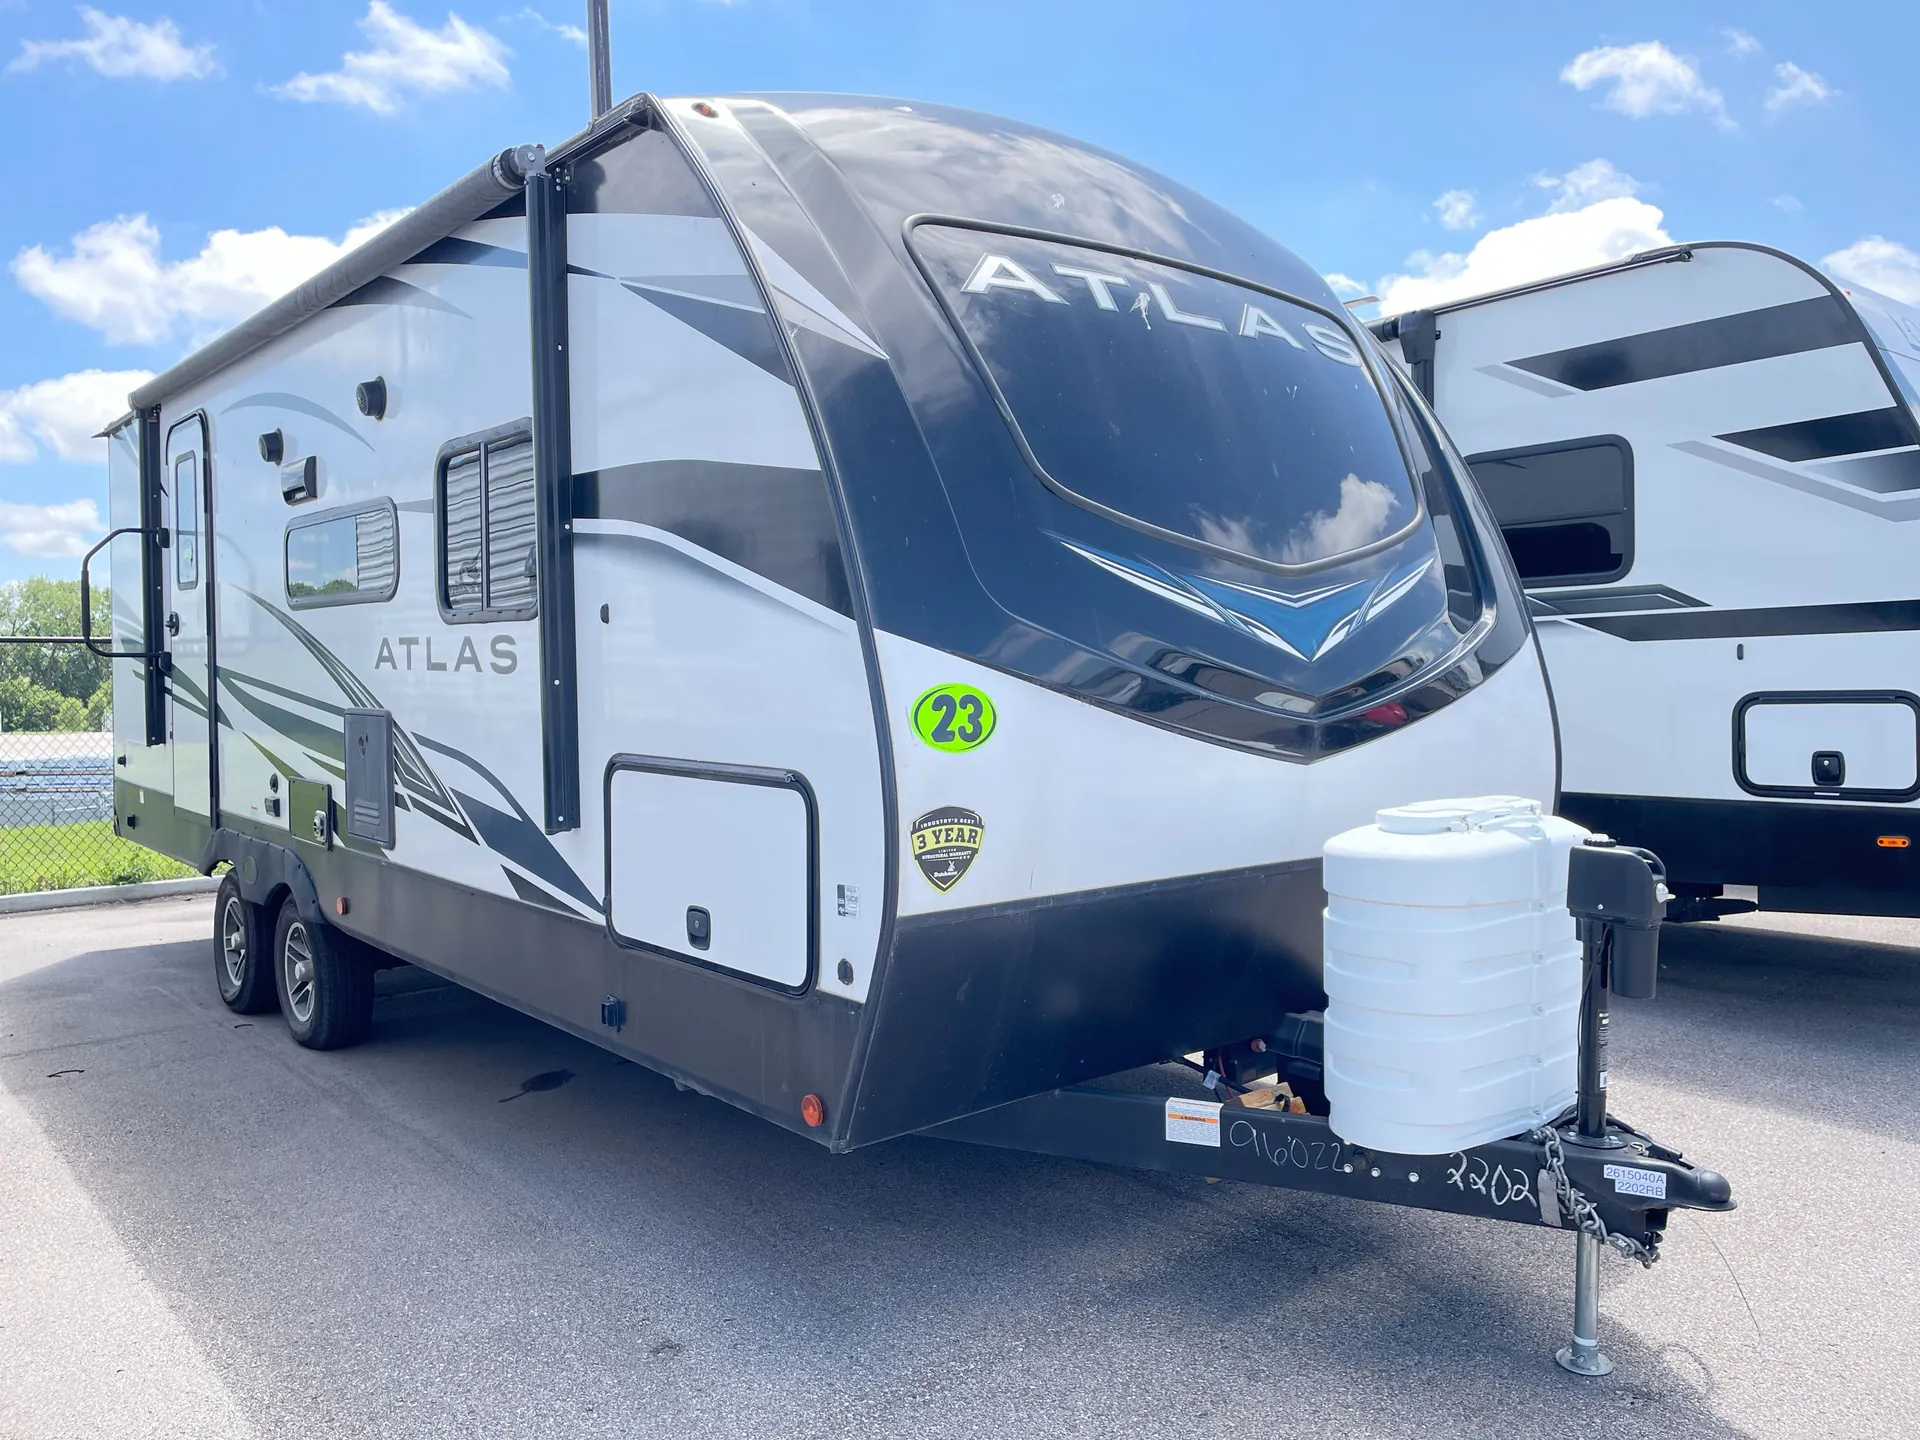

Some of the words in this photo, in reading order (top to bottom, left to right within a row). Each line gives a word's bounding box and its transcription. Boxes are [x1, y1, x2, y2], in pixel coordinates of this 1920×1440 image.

[960, 252, 1363, 368] ATLAS
[374, 634, 518, 675] ATLAS
[931, 694, 984, 743] 23
[916, 833, 927, 850] 3
[932, 828, 978, 845] YEAR
[1446, 1151, 1538, 1208] 2202
[1606, 1167, 1665, 1184] 2615040A
[1617, 1181, 1664, 1197] 2202RB
